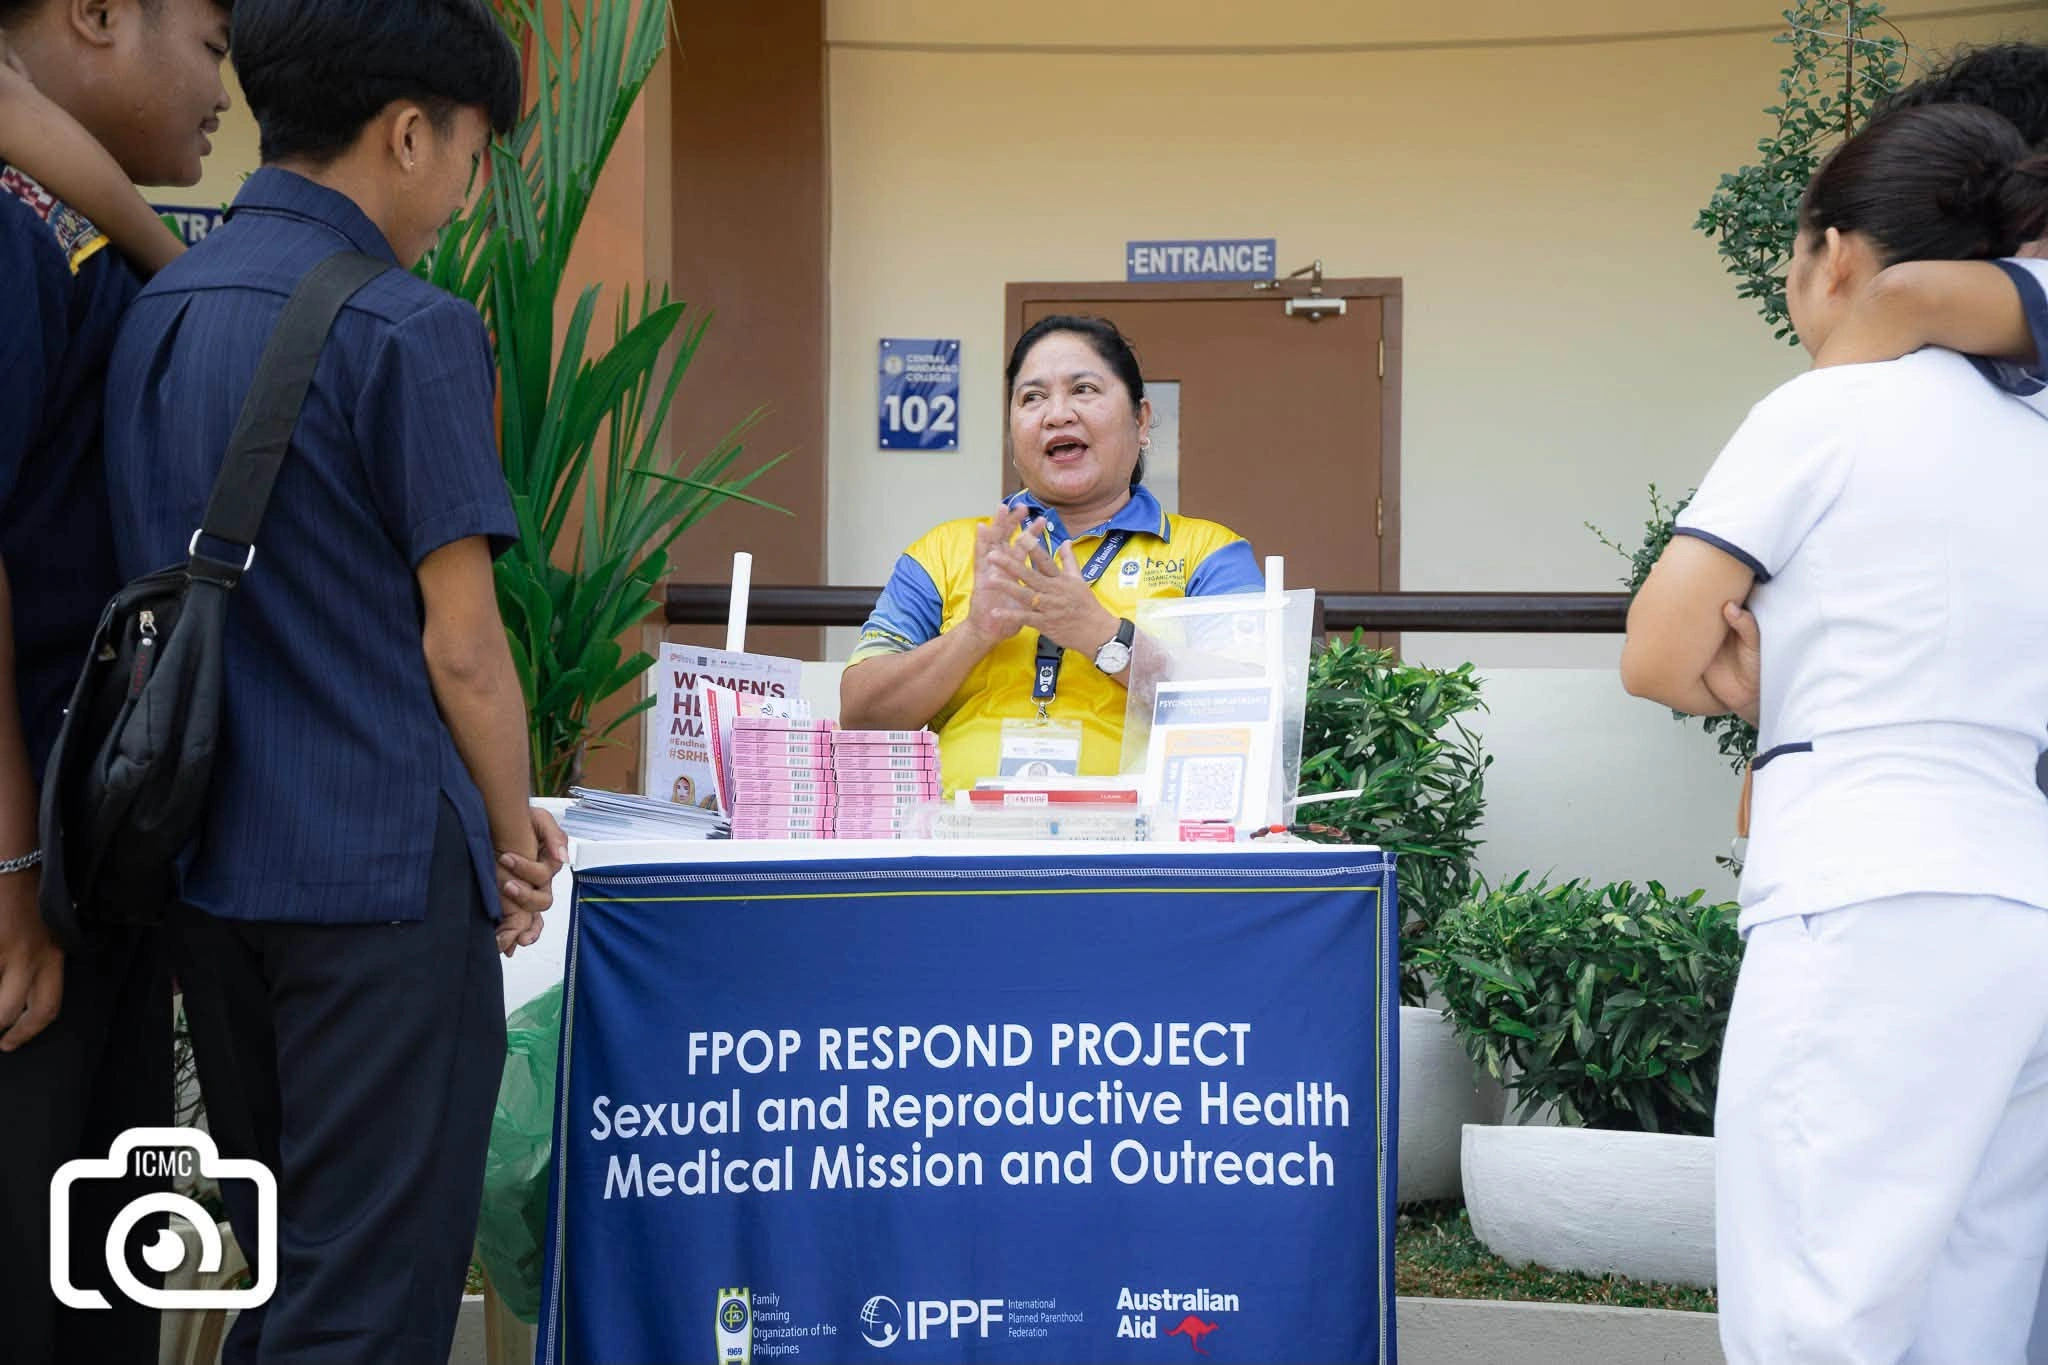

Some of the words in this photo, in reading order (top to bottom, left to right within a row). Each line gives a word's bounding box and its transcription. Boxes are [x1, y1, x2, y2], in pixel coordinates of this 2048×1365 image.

[1134, 244, 1270, 275] ENTRANCE
[884, 395, 956, 433] 102
[688, 1030, 801, 1075] FPOP
[819, 1024, 1033, 1071] RESPOND
[1051, 1022, 1252, 1067] PROJECT
[590, 1089, 740, 1141] Sexual
[757, 1085, 848, 1131] and
[867, 1079, 1183, 1138] Reproductive
[1201, 1081, 1350, 1127] Health
[603, 1146, 793, 1199] Medical
[809, 1141, 983, 1190] Mission
[1000, 1139, 1093, 1186] and
[1110, 1138, 1335, 1187] Outreach
[752, 1293, 780, 1306] Family
[1008, 1299, 1056, 1309] International
[1116, 1287, 1240, 1312] Australian
[752, 1310, 790, 1323] Planning
[907, 1299, 1004, 1341] IPPF
[1008, 1313, 1039, 1324] Planned
[1040, 1312, 1083, 1323] Parenthood
[753, 1326, 809, 1341] Organization
[811, 1326, 820, 1336] of
[822, 1325, 837, 1336] the
[1008, 1327, 1048, 1338] Federation
[1116, 1315, 1157, 1339] Aid
[727, 1347, 743, 1356] 1969
[753, 1343, 800, 1358] Philippines
